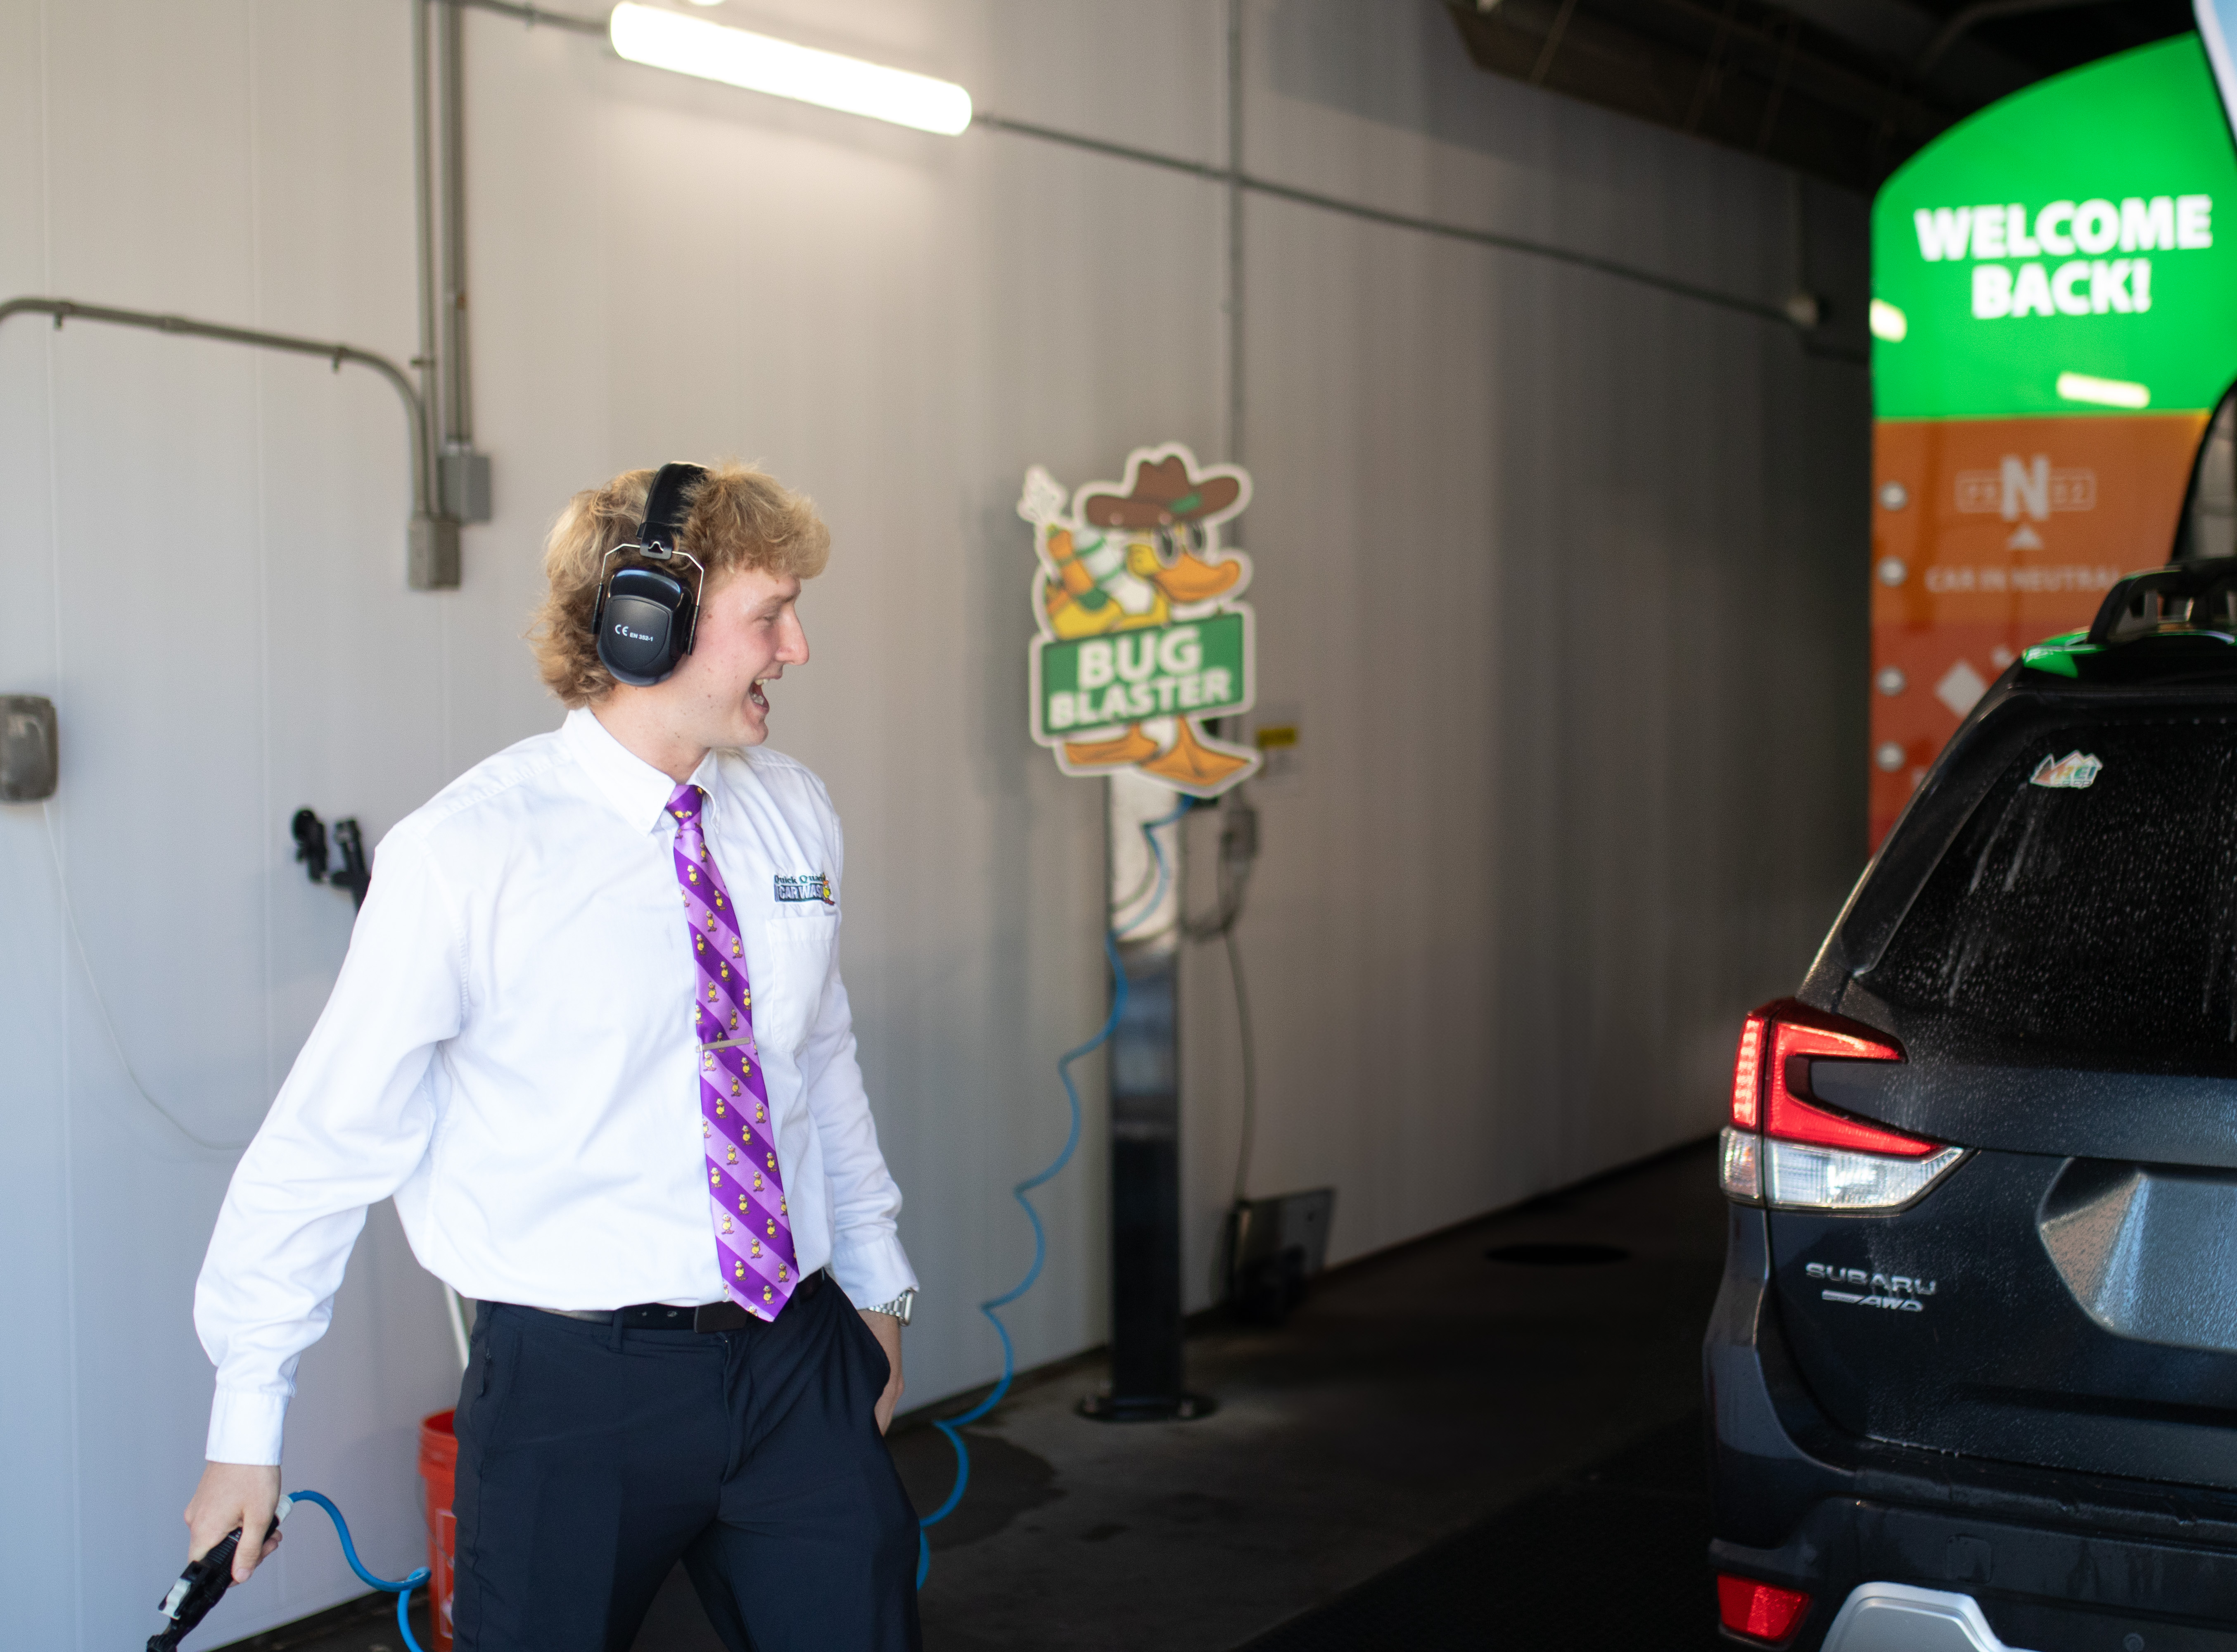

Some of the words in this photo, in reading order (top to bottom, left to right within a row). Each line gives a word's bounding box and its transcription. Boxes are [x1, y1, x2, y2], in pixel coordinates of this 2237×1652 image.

[1913, 194, 2213, 261] WELCOME
[1971, 258, 2152, 319] BACK!
[2000, 454, 2050, 521] N
[1077, 626, 1202, 690] BUG
[1049, 667, 1232, 730] BLASTER
[2056, 765, 2096, 779] REI
[774, 875, 797, 884] Quick
[778, 886, 799, 899] CAR
[799, 884, 823, 899] WAS
[1805, 1262, 1936, 1295] SUBARU
[1858, 1295, 1924, 1312] AWD
